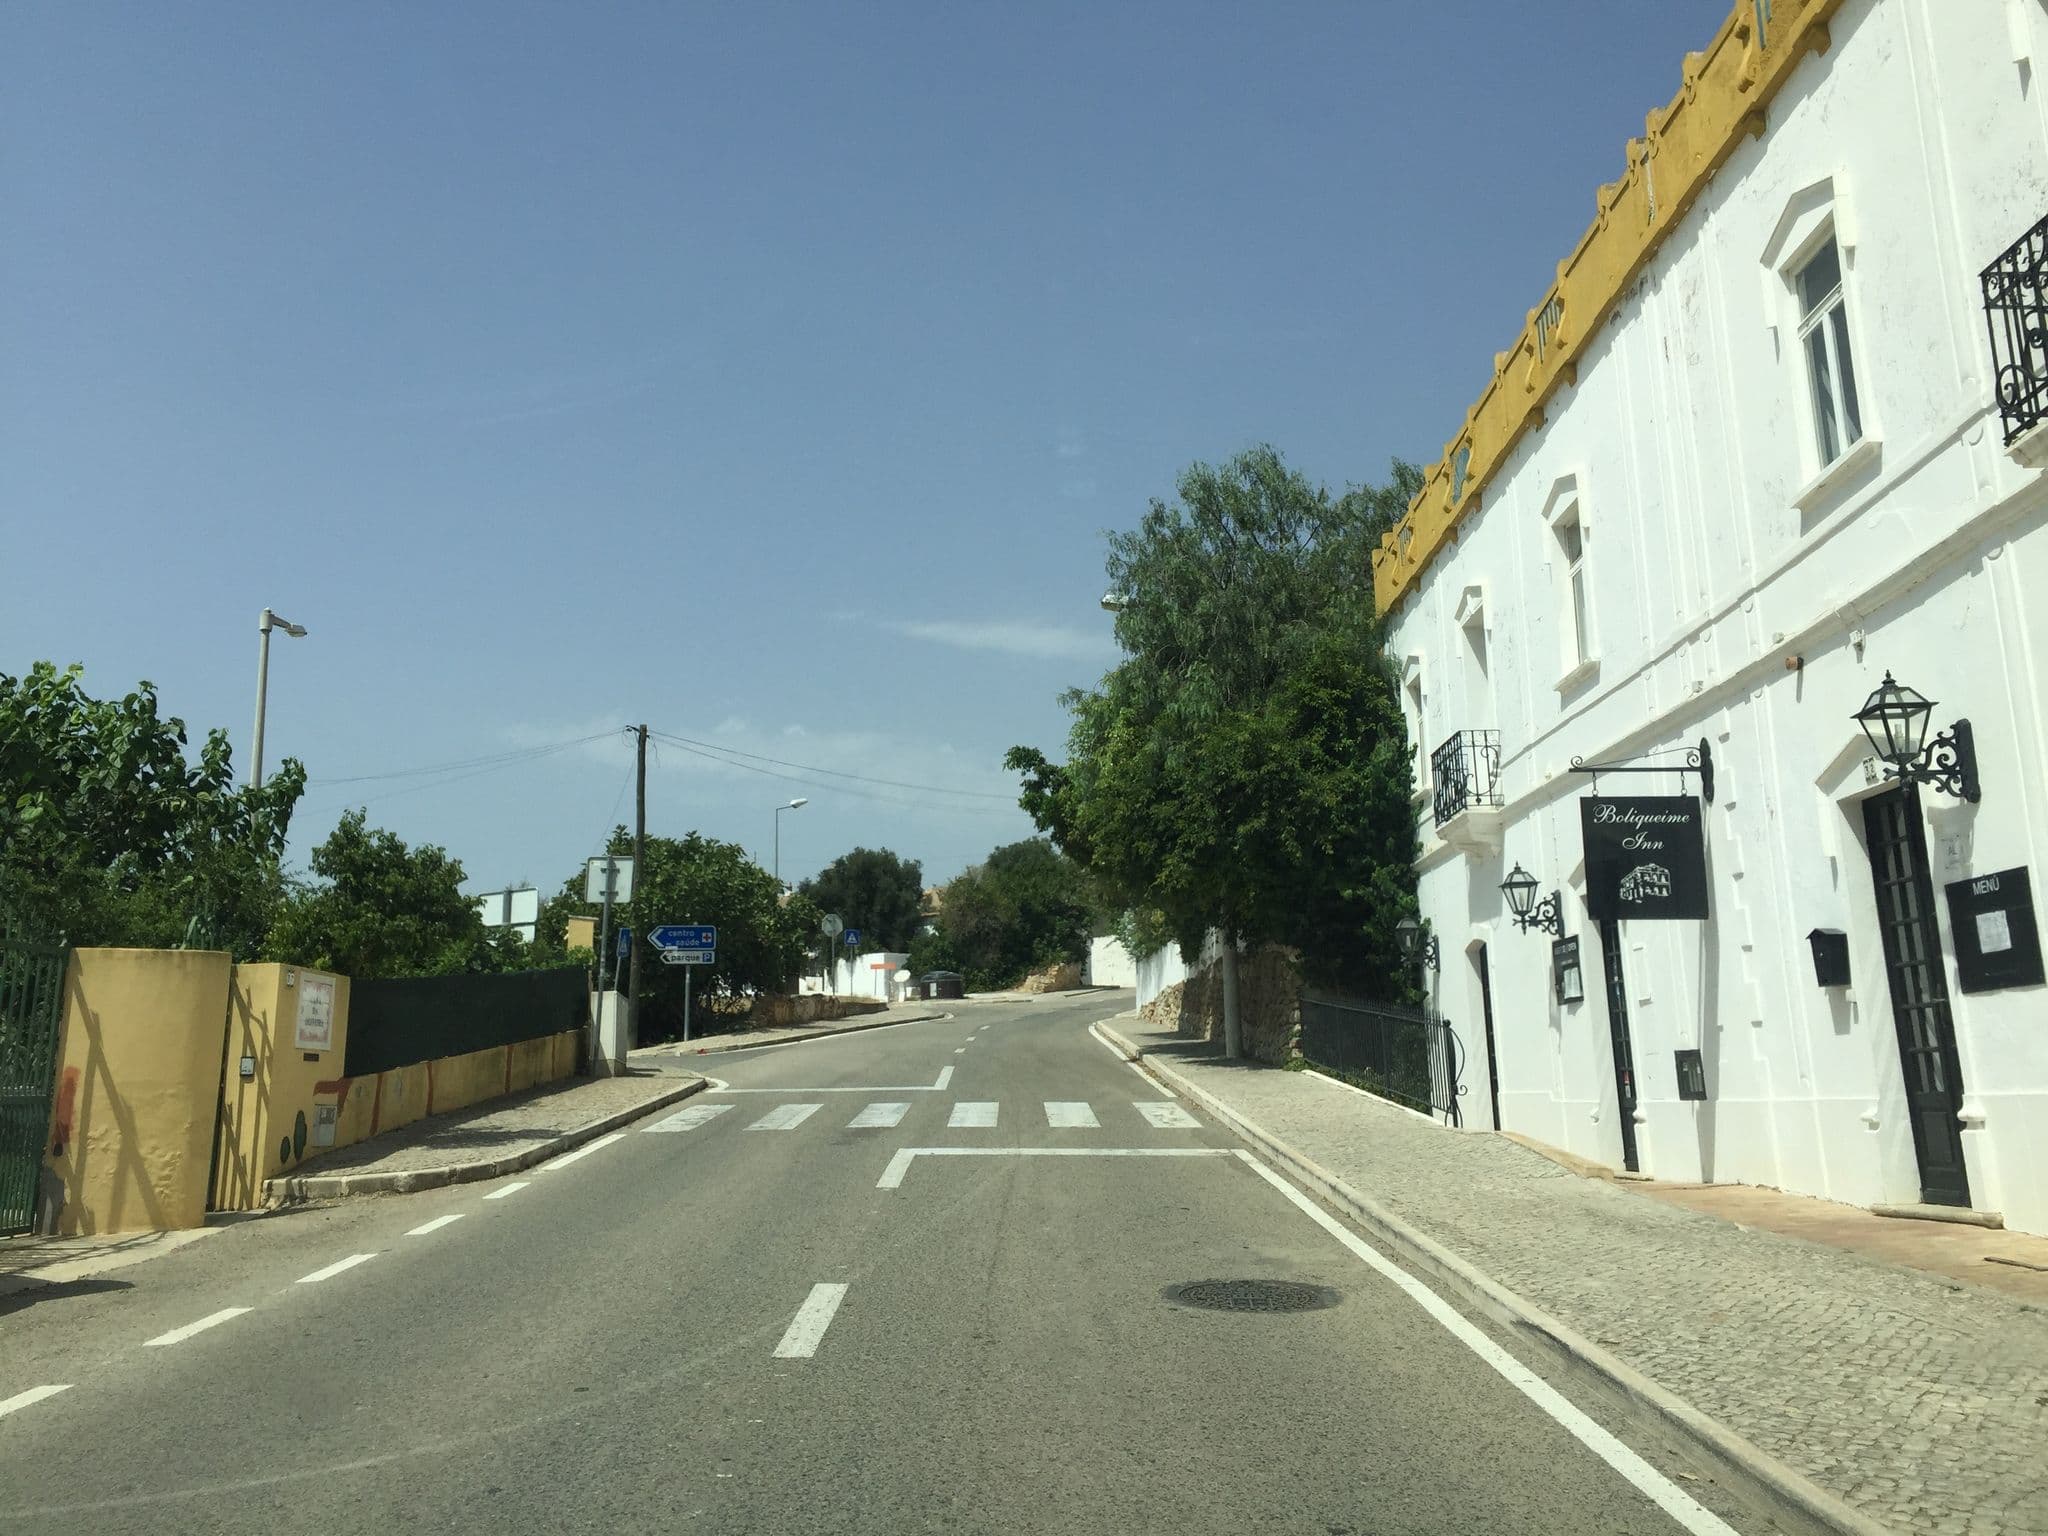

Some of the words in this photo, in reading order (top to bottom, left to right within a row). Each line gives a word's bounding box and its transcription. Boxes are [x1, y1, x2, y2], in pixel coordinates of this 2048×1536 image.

[1593, 804, 1690, 829] Boliqueime
[1622, 831, 1664, 850] Inn
[671, 954, 700, 962] parque
